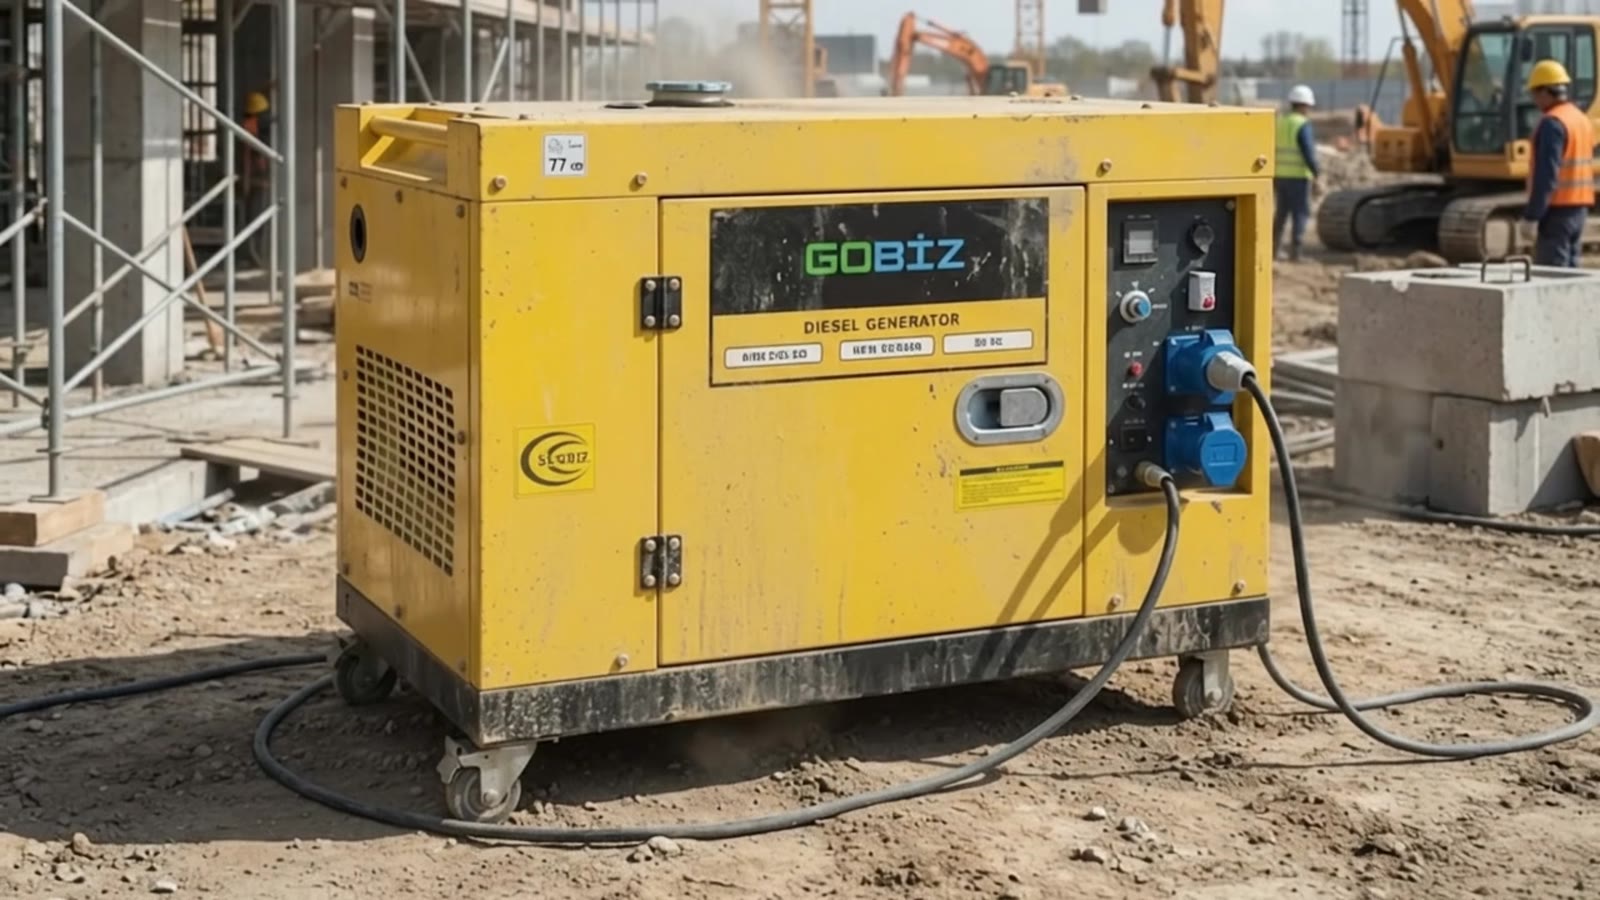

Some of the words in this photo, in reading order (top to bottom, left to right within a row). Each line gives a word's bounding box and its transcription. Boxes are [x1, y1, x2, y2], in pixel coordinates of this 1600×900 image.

[548, 157, 567, 172] 77
[803, 318, 860, 335] DIESEL
[866, 313, 960, 331] GENERATOR
